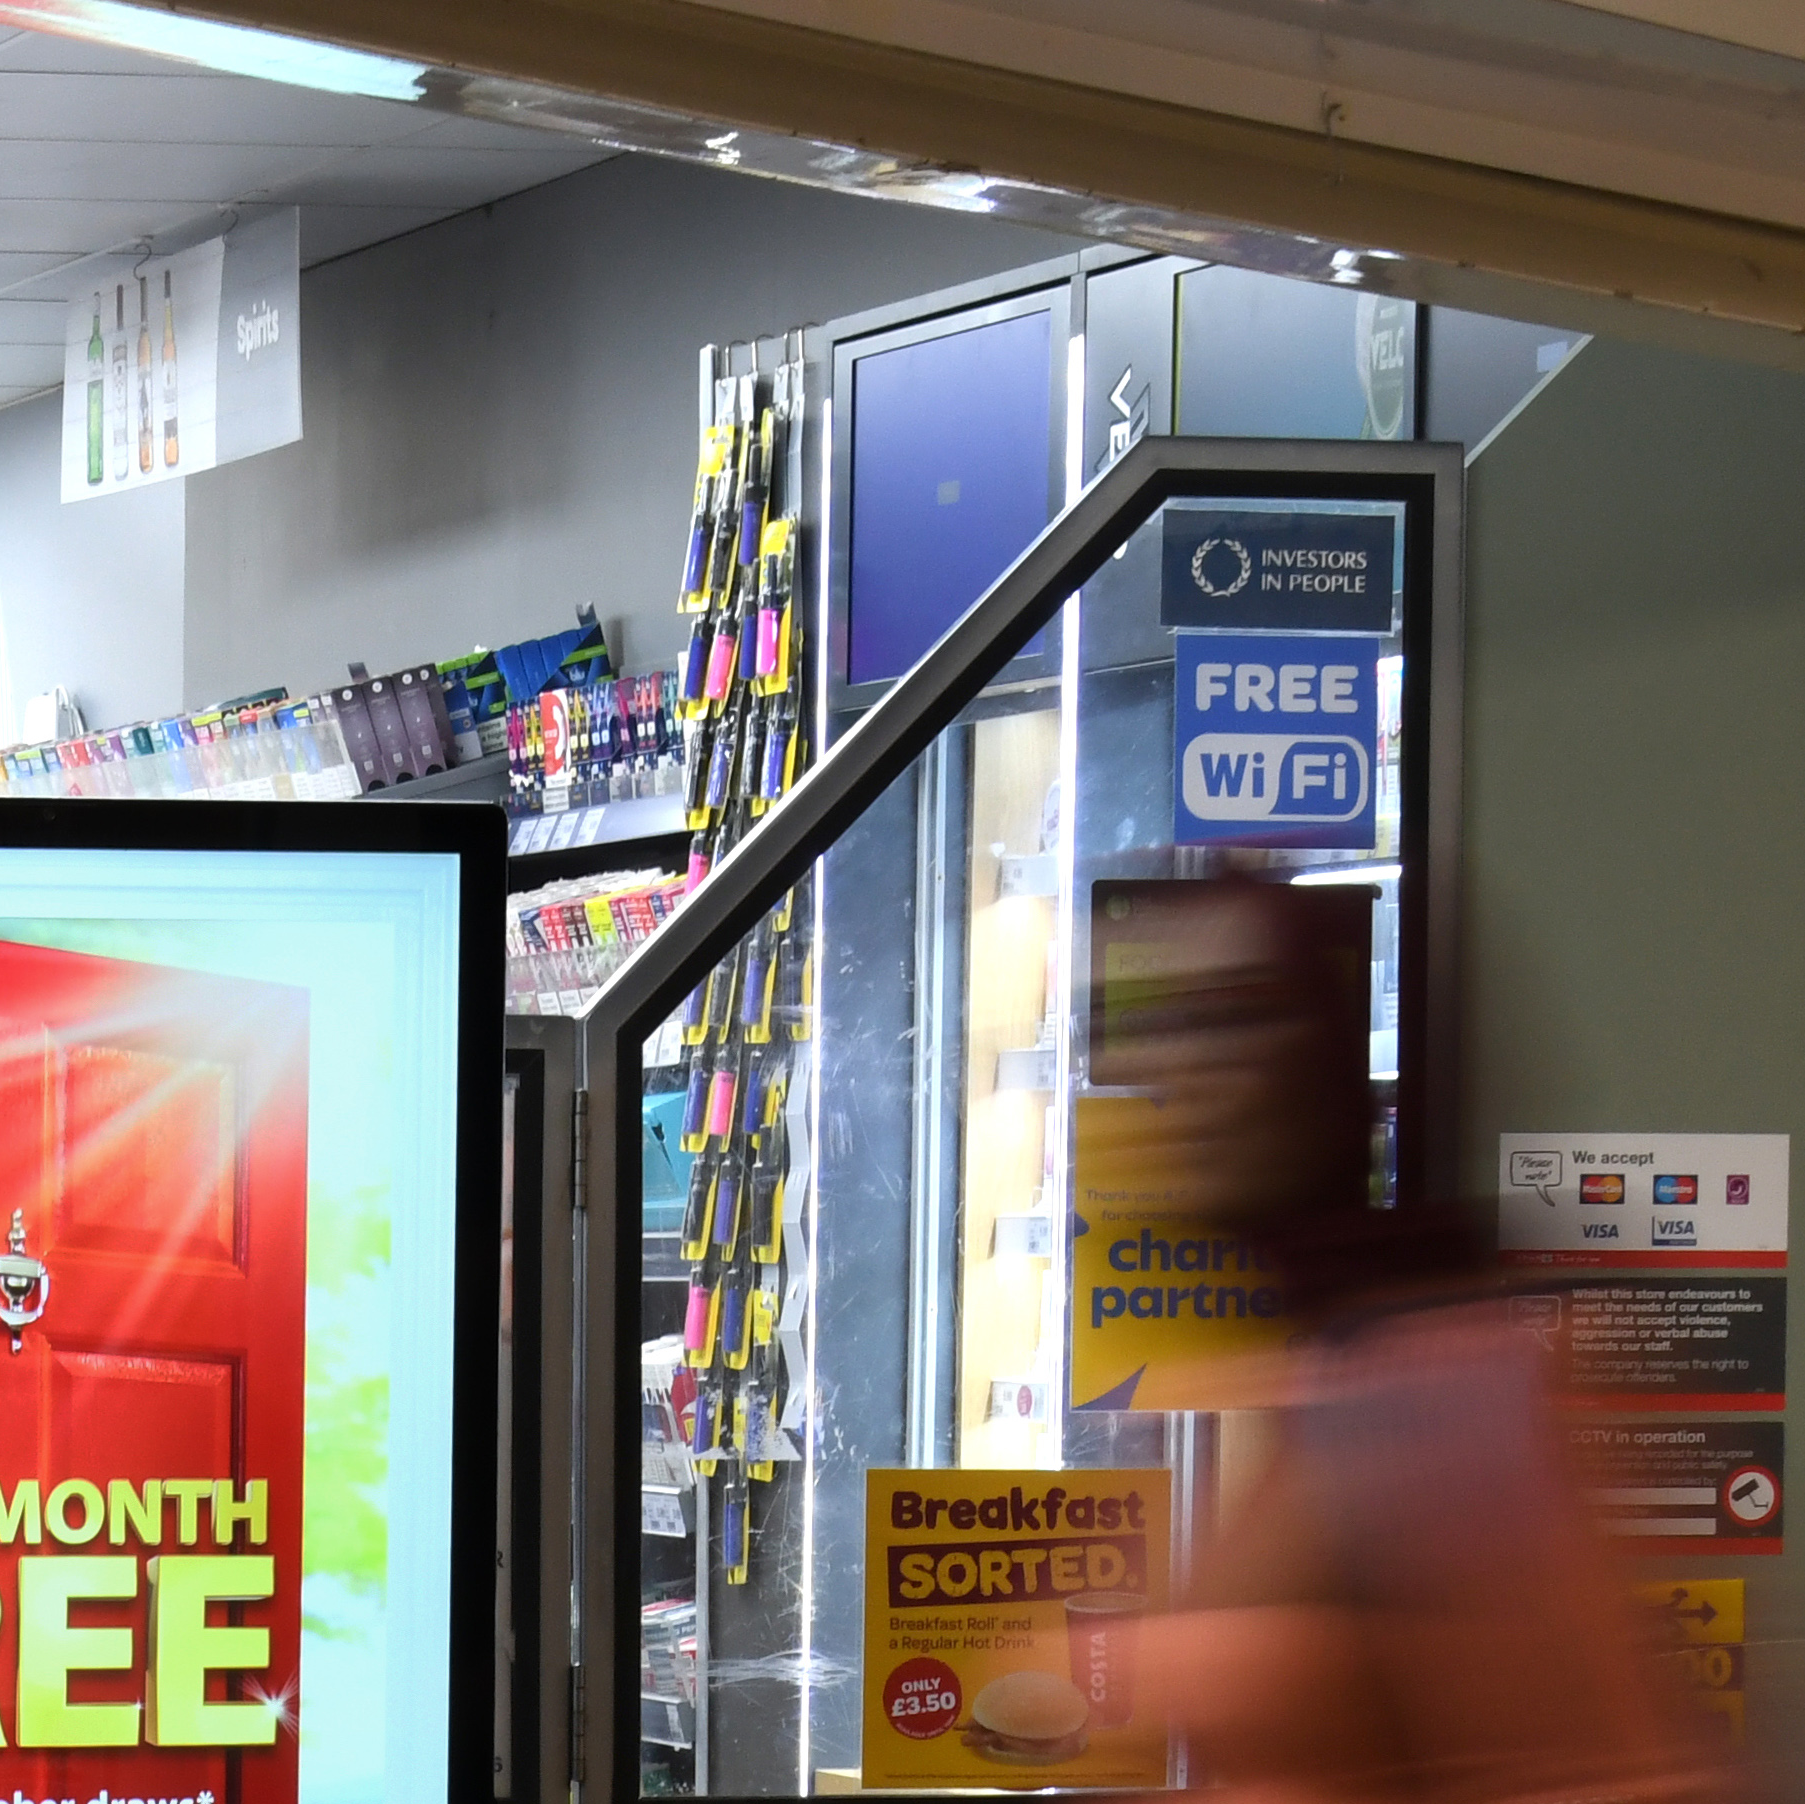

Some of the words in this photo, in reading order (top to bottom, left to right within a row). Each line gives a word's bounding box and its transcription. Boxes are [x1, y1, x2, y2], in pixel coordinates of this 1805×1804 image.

[237, 301, 280, 361] Spirits
[1262, 549, 1369, 573] INVESTORS
[1262, 572, 1281, 594] IN
[1286, 571, 1368, 595] PEOPLE
[1196, 662, 1360, 713] FREE
[1573, 1151, 1596, 1164] We
[1601, 1152, 1655, 1167] accept
[1659, 1185, 1693, 1195] Maestro
[1583, 1224, 1620, 1239] VISA
[1658, 1221, 1695, 1235] VISA
[1572, 1289, 1608, 1300] Whilst
[1612, 1289, 1633, 1300] this
[1636, 1289, 1666, 1300] store
[1669, 1289, 1736, 1300] endeavours
[1739, 1289, 1751, 1300] to
[1605, 1302, 1623, 1313] the
[1626, 1302, 1661, 1313] needs
[1665, 1302, 1677, 1313] of
[1680, 1302, 1699, 1313] our
[1702, 1302, 1764, 1313] customers
[1573, 1315, 1589, 1327] we
[1615, 1315, 1633, 1327] not
[1637, 1315, 1677, 1327] accept
[1680, 1315, 1731, 1327] violence,
[1572, 1329, 1636, 1342] aggression
[1639, 1329, 1651, 1342] or
[1655, 1329, 1690, 1342] verbal
[1693, 1329, 1729, 1342] abuse
[1622, 1341, 1642, 1352] our
[1645, 1341, 1674, 1352] staff.
[1693, 1358, 1708, 1372] the
[1711, 1358, 1736, 1372] right
[1738, 1358, 1749, 1372] to
[1616, 1430, 1630, 1444] in
[1634, 1429, 1706, 1447] operation
[890, 1487, 1146, 1532] Breakfast
[898, 1544, 1140, 1600] SORTED.
[890, 1617, 963, 1631] Breakfast
[1003, 1617, 1032, 1631] and
[889, 1638, 898, 1650] a
[902, 1637, 959, 1653] Regular
[963, 1637, 990, 1650] Hot
[995, 1637, 1034, 1650] Drink
[1090, 1631, 1107, 1703] COSTA
[901, 1677, 942, 1694] ONLY
[891, 1691, 957, 1718] £3.50
